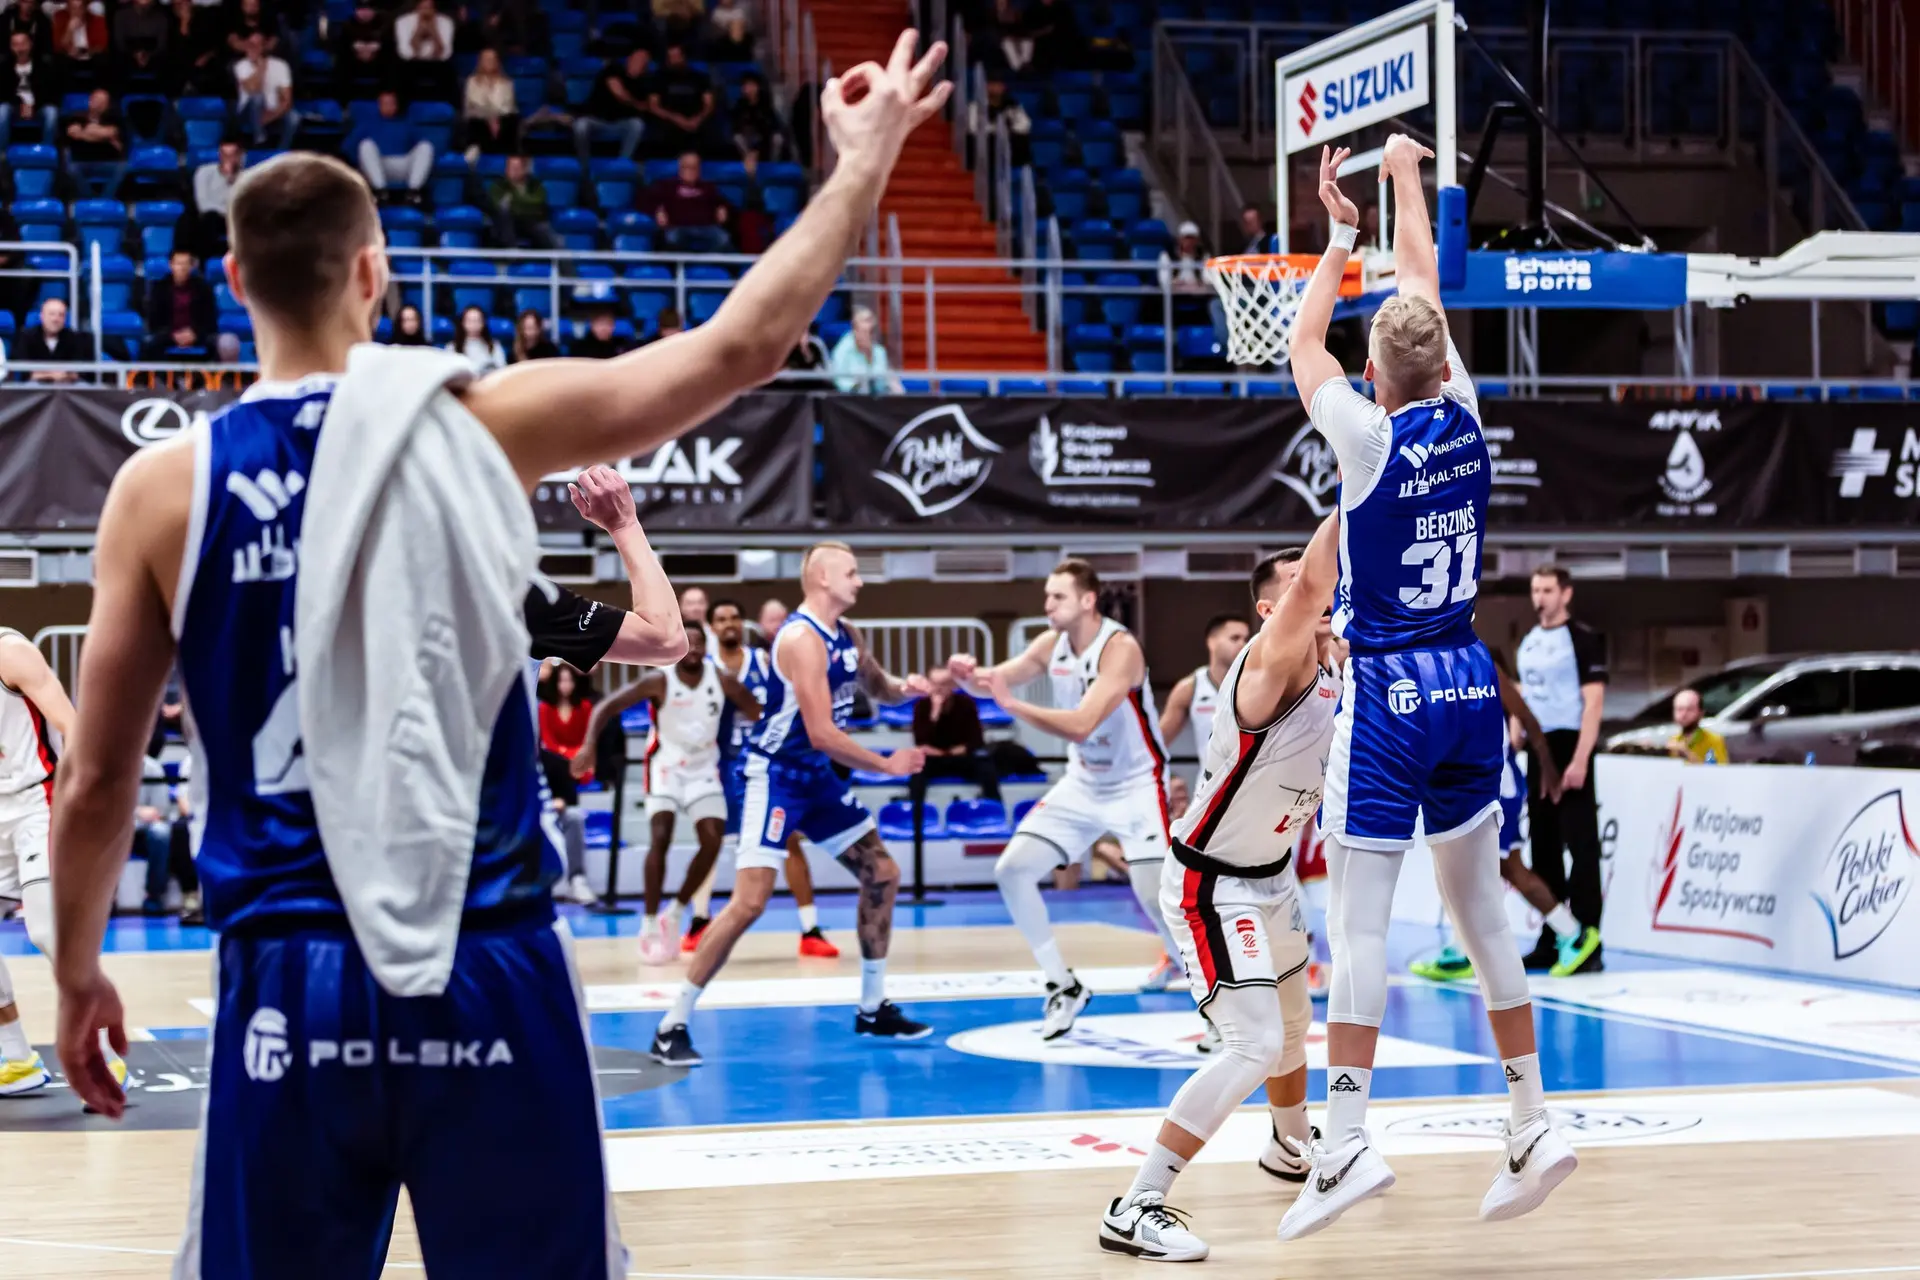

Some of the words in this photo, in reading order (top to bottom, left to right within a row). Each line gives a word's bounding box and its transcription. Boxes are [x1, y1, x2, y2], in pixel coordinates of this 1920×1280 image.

[1324, 51, 1413, 120] SUZUKI
[1505, 274, 1592, 294] Sports
[1428, 458, 1481, 487] KAL-TECH
[1398, 531, 1478, 610] 31
[1430, 685, 1497, 704] POLSKA
[1693, 804, 1764, 843] Krajowa
[1686, 842, 1742, 880] Grupa
[1835, 831, 1897, 894] Polski
[1678, 879, 1777, 919] Spożywcza
[1838, 875, 1905, 926] Cukier
[308, 1037, 513, 1069] POLSKA
[1330, 1085, 1362, 1093] PEAK
